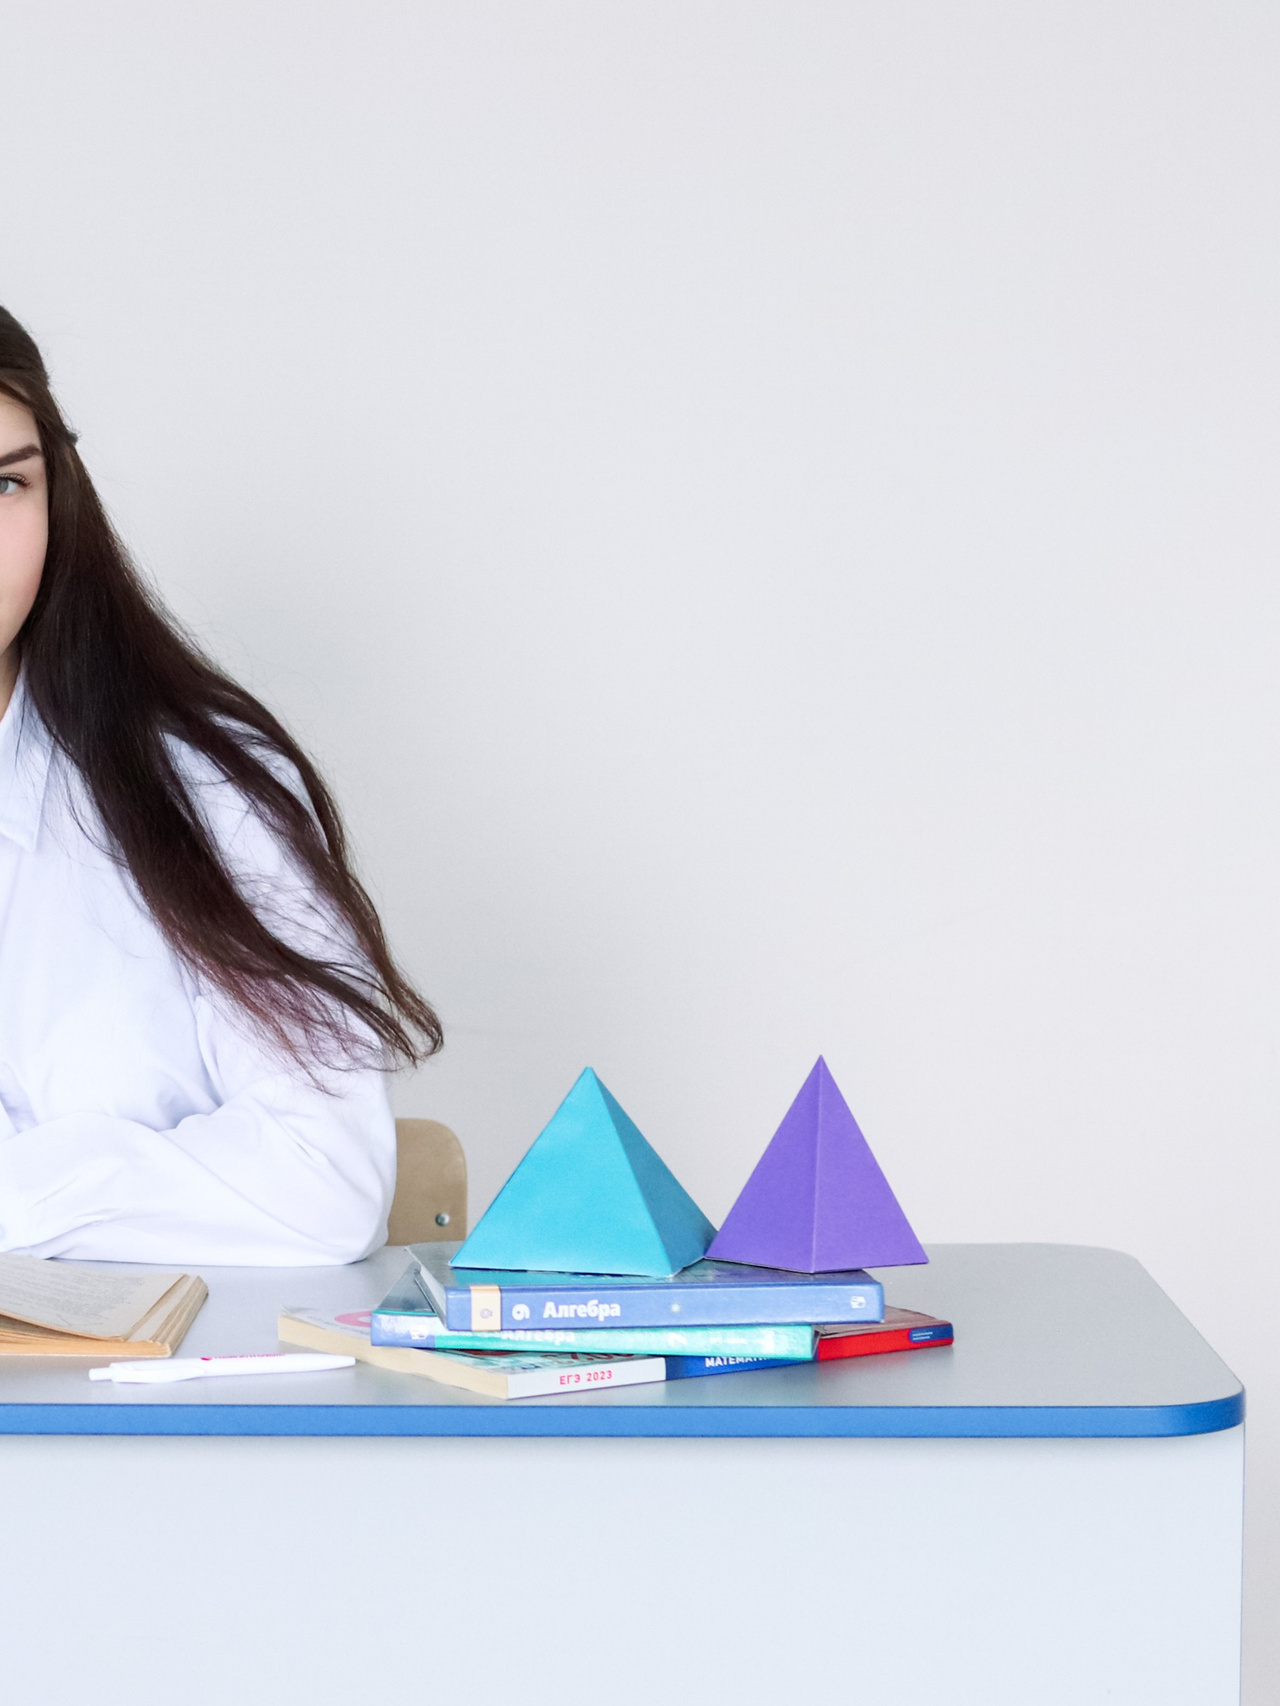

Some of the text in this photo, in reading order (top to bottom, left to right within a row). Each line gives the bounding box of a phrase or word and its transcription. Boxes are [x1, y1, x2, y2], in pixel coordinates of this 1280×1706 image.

[543, 1299, 621, 1321] Алгебра
[560, 1370, 613, 1385] ЕГЭ 2023
